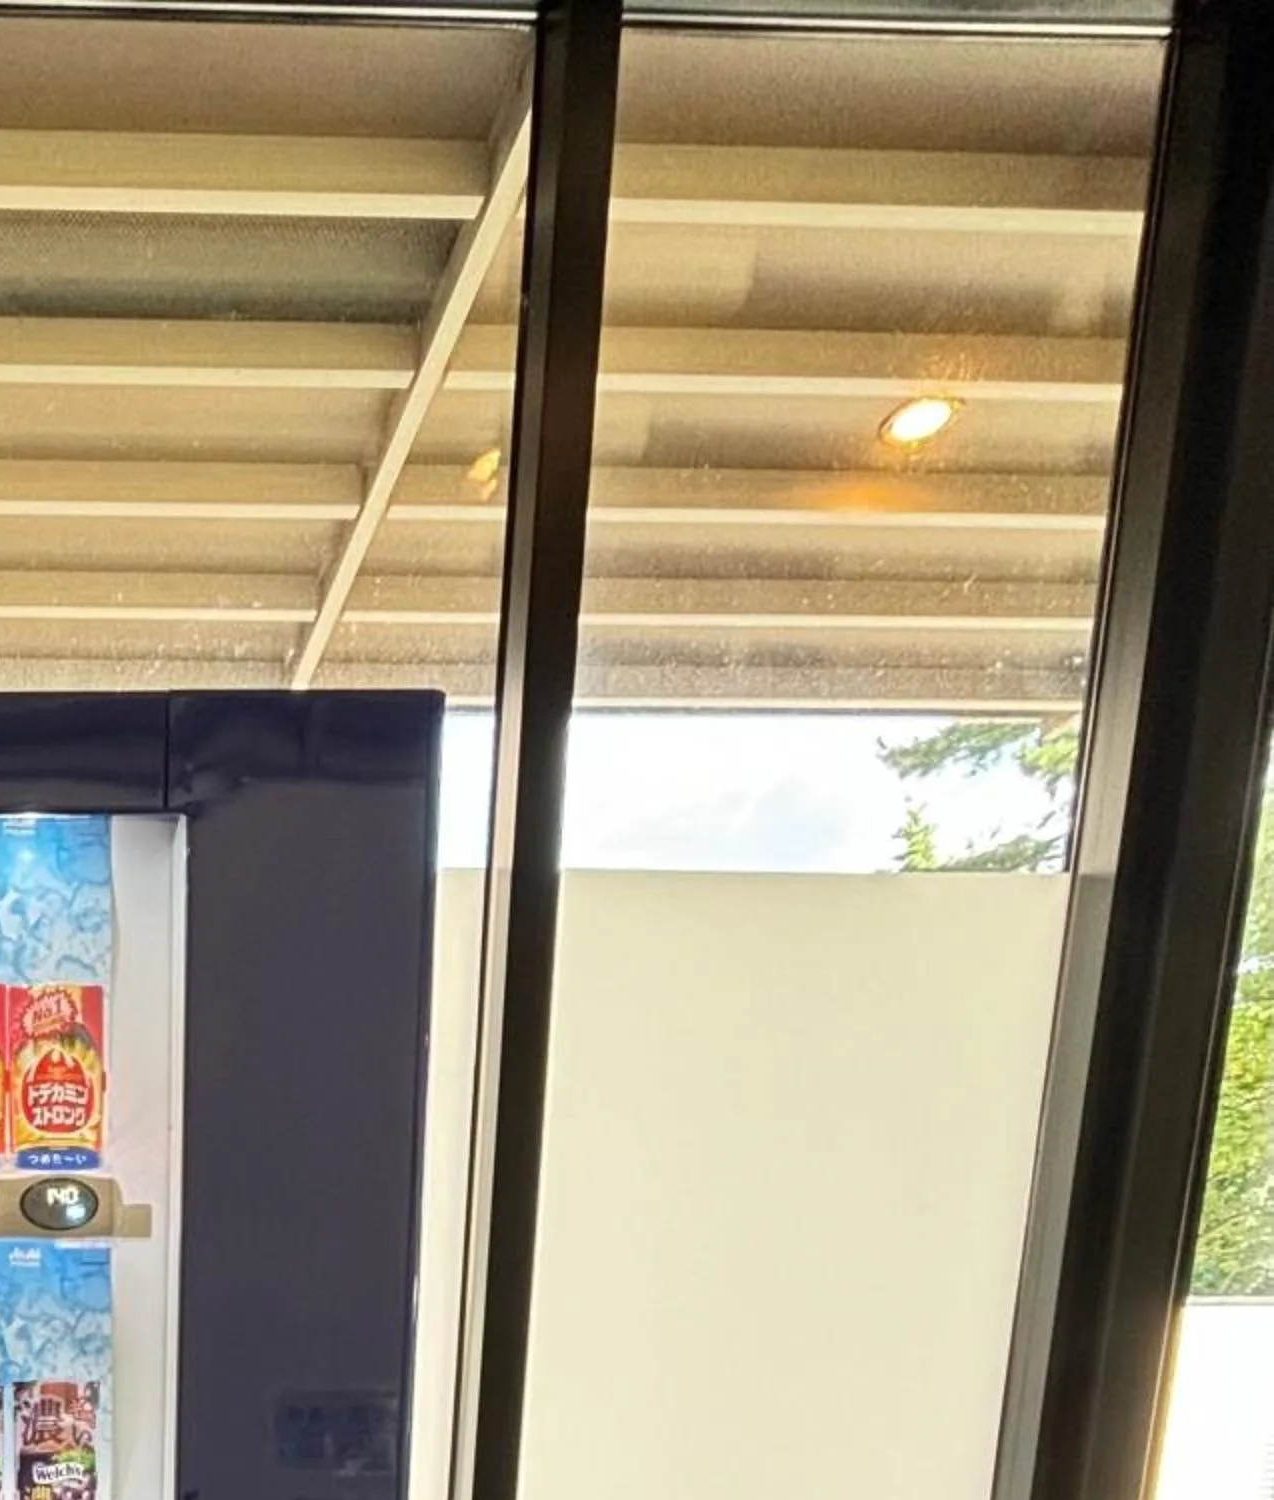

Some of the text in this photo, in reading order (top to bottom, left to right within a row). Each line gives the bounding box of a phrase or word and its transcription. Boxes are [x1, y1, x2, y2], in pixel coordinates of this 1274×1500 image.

[32, 1105, 86, 1127] ストロング
[46, 1186, 79, 1206] 140
